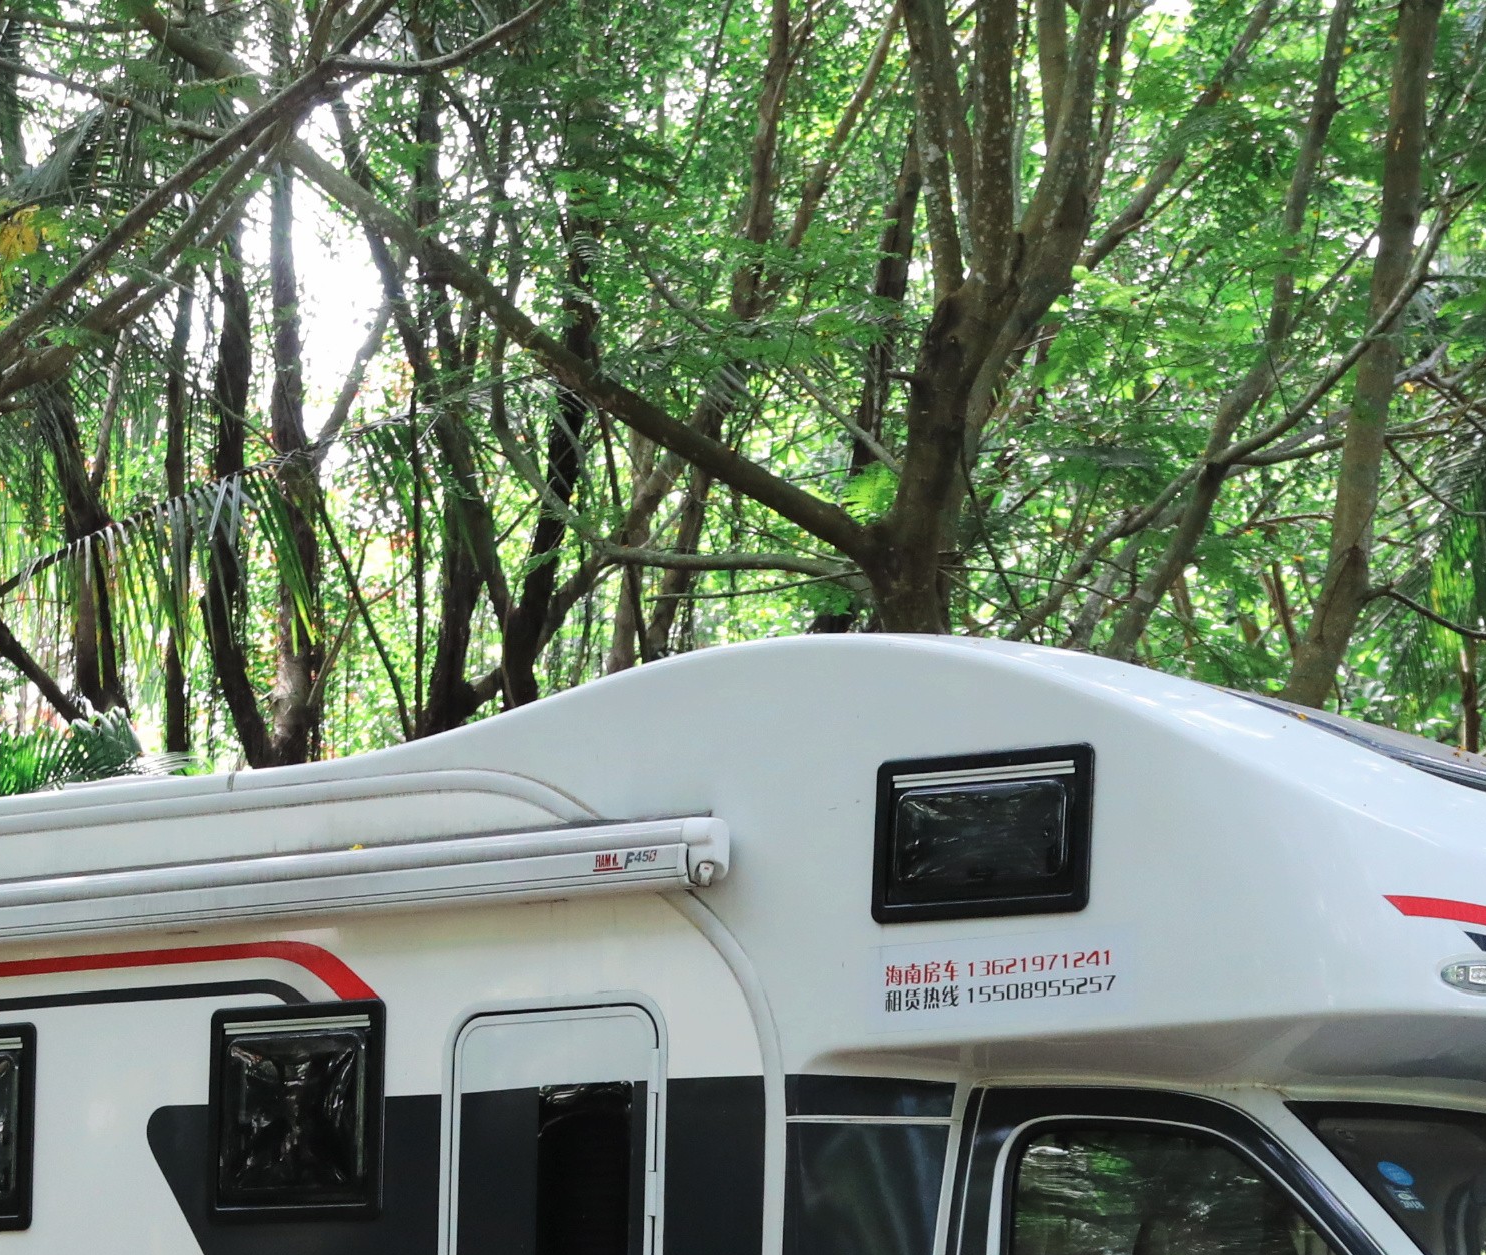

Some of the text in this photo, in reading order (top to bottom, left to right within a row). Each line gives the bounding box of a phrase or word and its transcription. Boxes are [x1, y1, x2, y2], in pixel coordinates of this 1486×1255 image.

[885, 949, 1111, 986] 海南房车 13621971241
[885, 974, 1117, 1012] 租赁热线 15508955257
